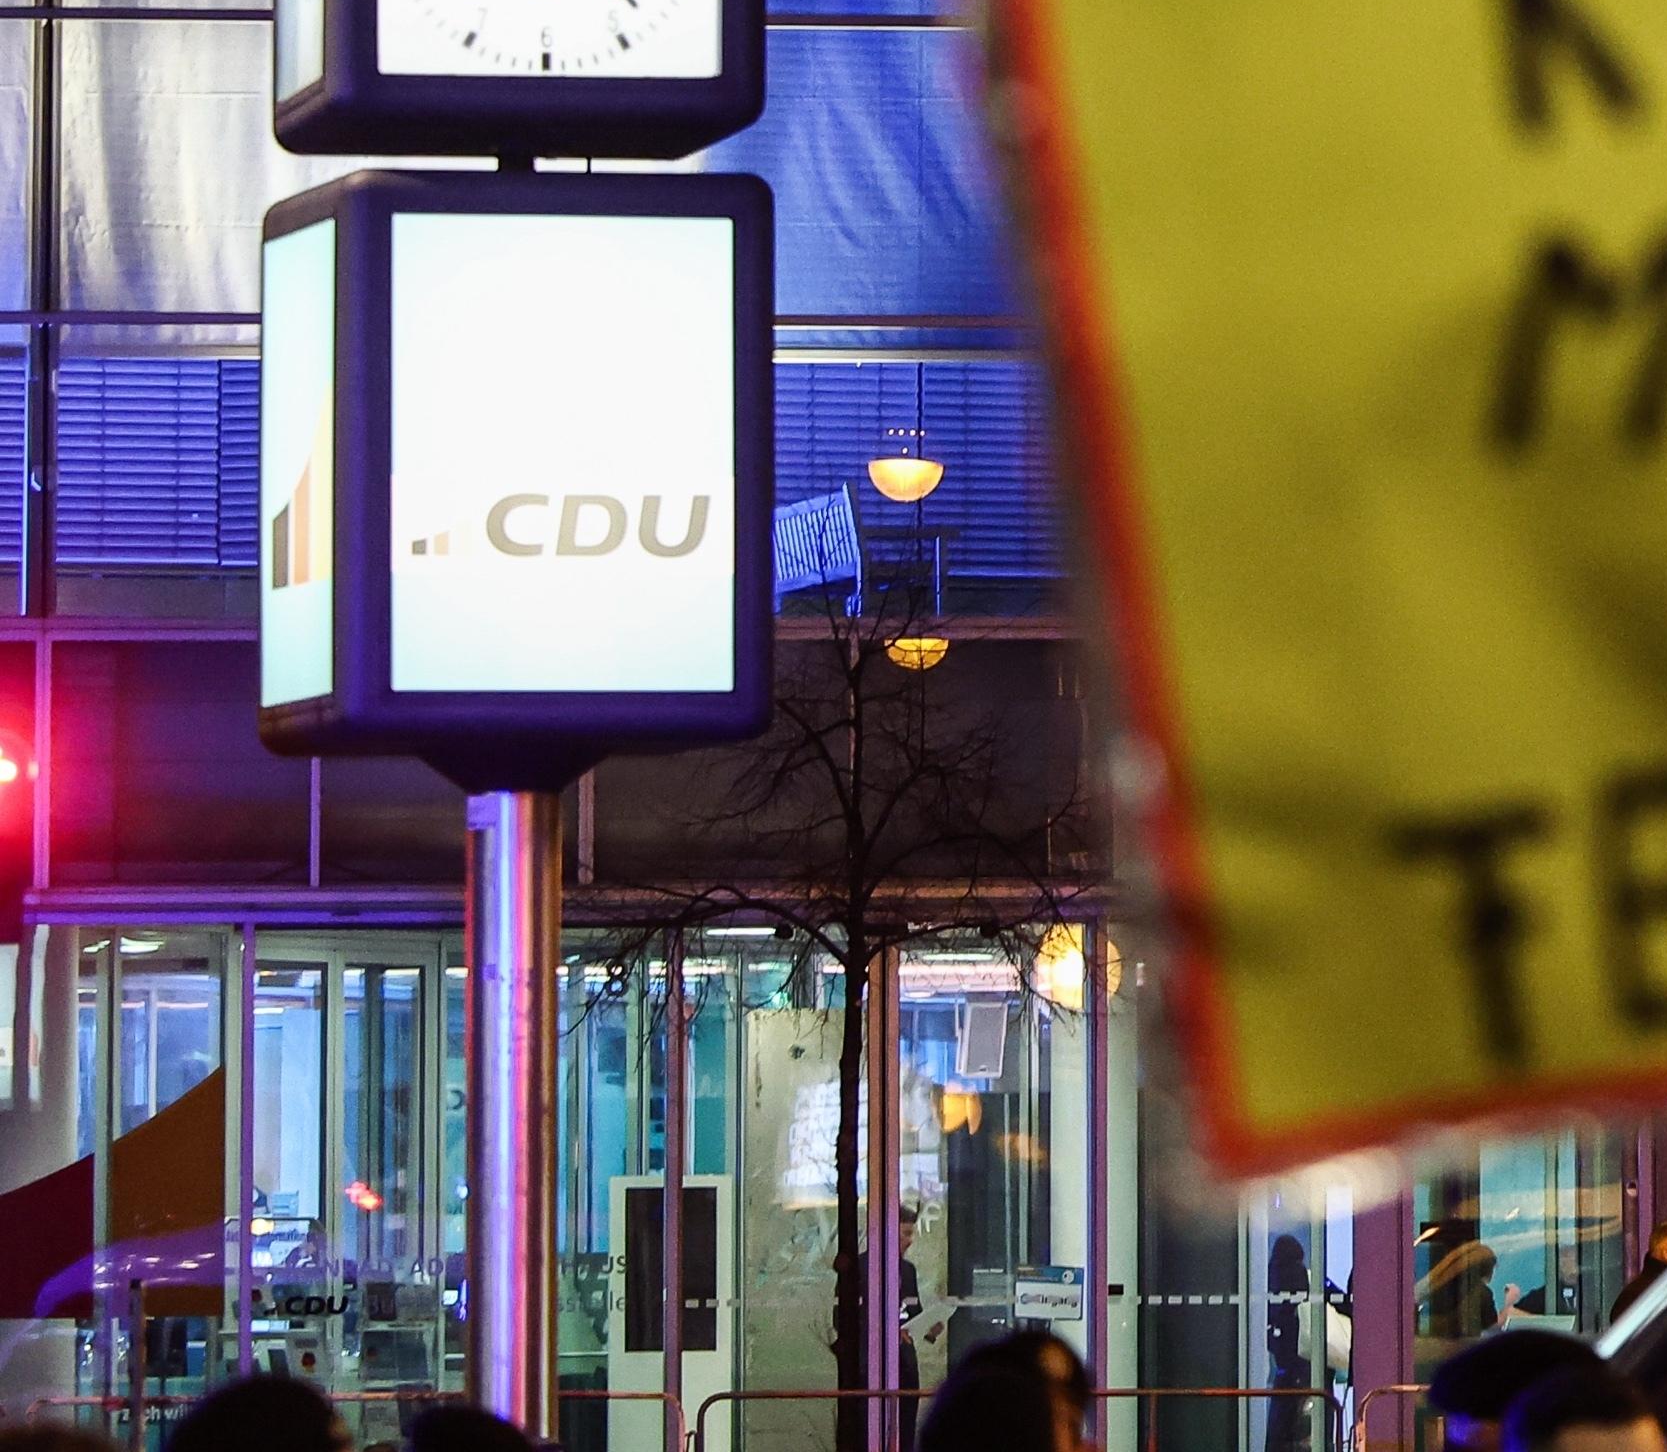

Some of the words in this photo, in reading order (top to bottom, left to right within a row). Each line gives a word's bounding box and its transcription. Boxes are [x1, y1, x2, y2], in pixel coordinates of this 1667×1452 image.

[540, 26, 552, 48] 6
[486, 493, 711, 558] CDU
[285, 1296, 348, 1314] CDU
